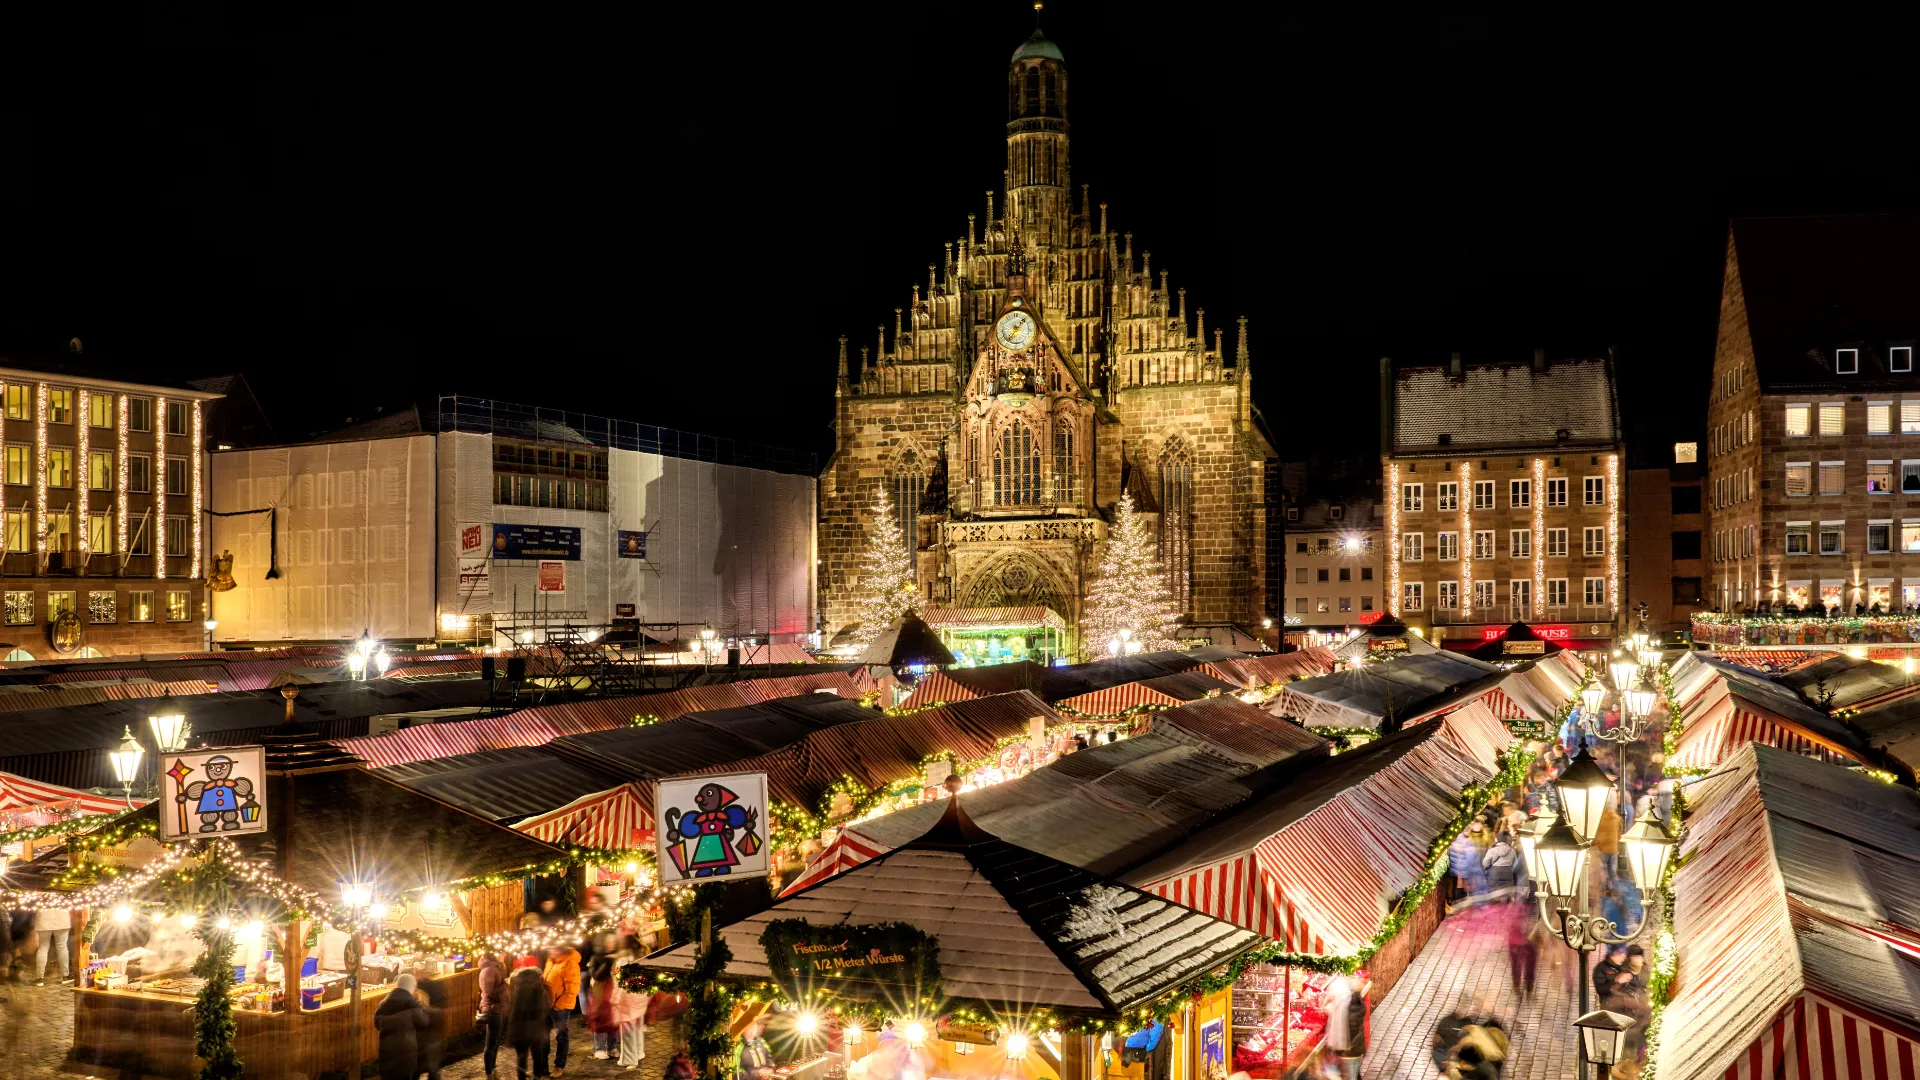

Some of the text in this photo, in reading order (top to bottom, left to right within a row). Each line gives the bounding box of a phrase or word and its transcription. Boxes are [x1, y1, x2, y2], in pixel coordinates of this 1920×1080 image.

[462, 534, 481, 550] NEU
[813, 953, 905, 971] 1/2 Meter Würste
